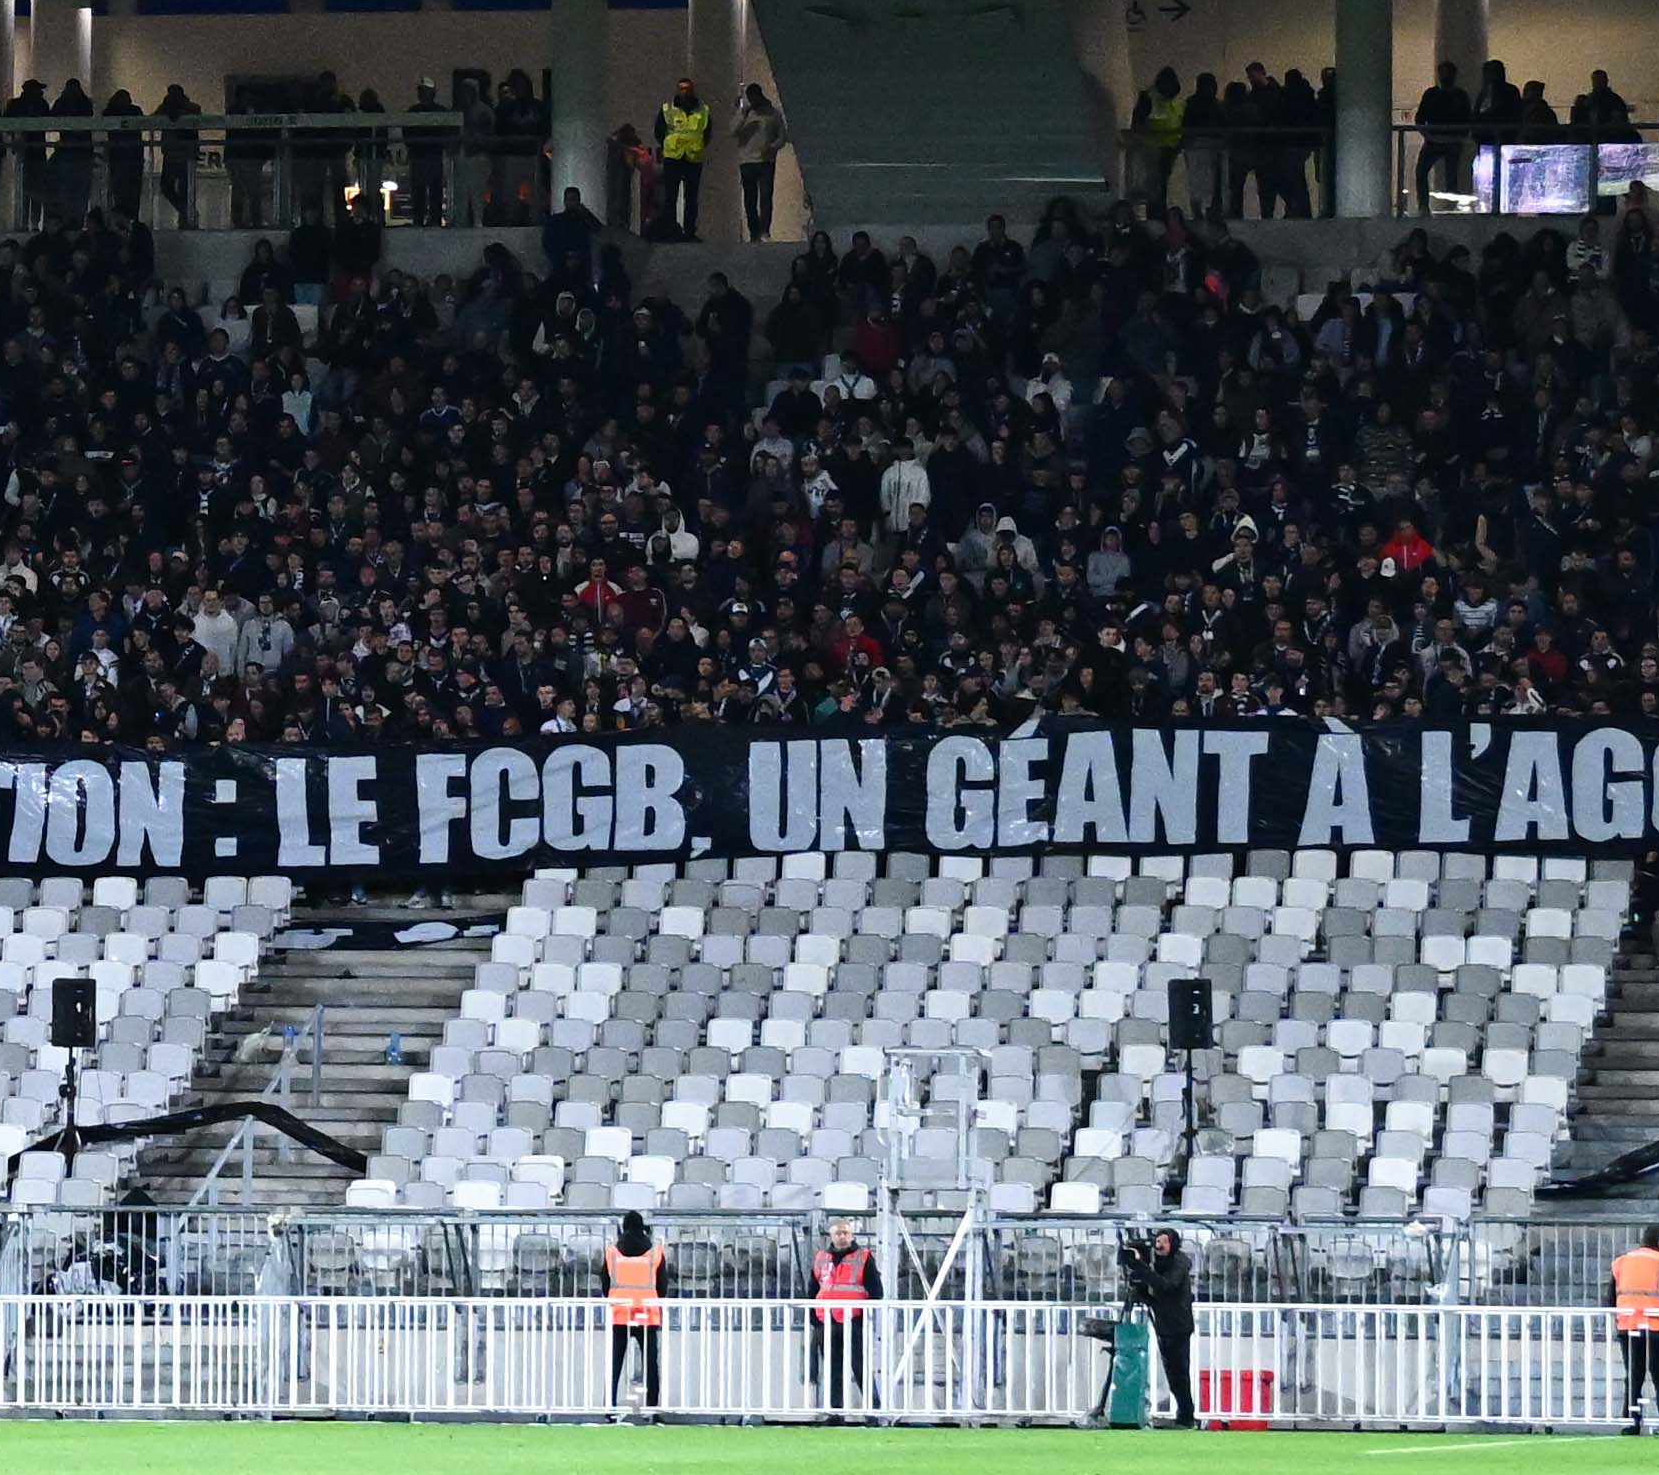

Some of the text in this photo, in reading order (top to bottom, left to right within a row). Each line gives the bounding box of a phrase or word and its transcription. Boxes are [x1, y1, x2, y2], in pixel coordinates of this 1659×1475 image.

[275, 755, 380, 867] LE
[415, 742, 714, 867] FCGB,
[747, 738, 886, 852] UN
[924, 716, 1270, 851] GÉANT
[1296, 716, 1376, 846] À
